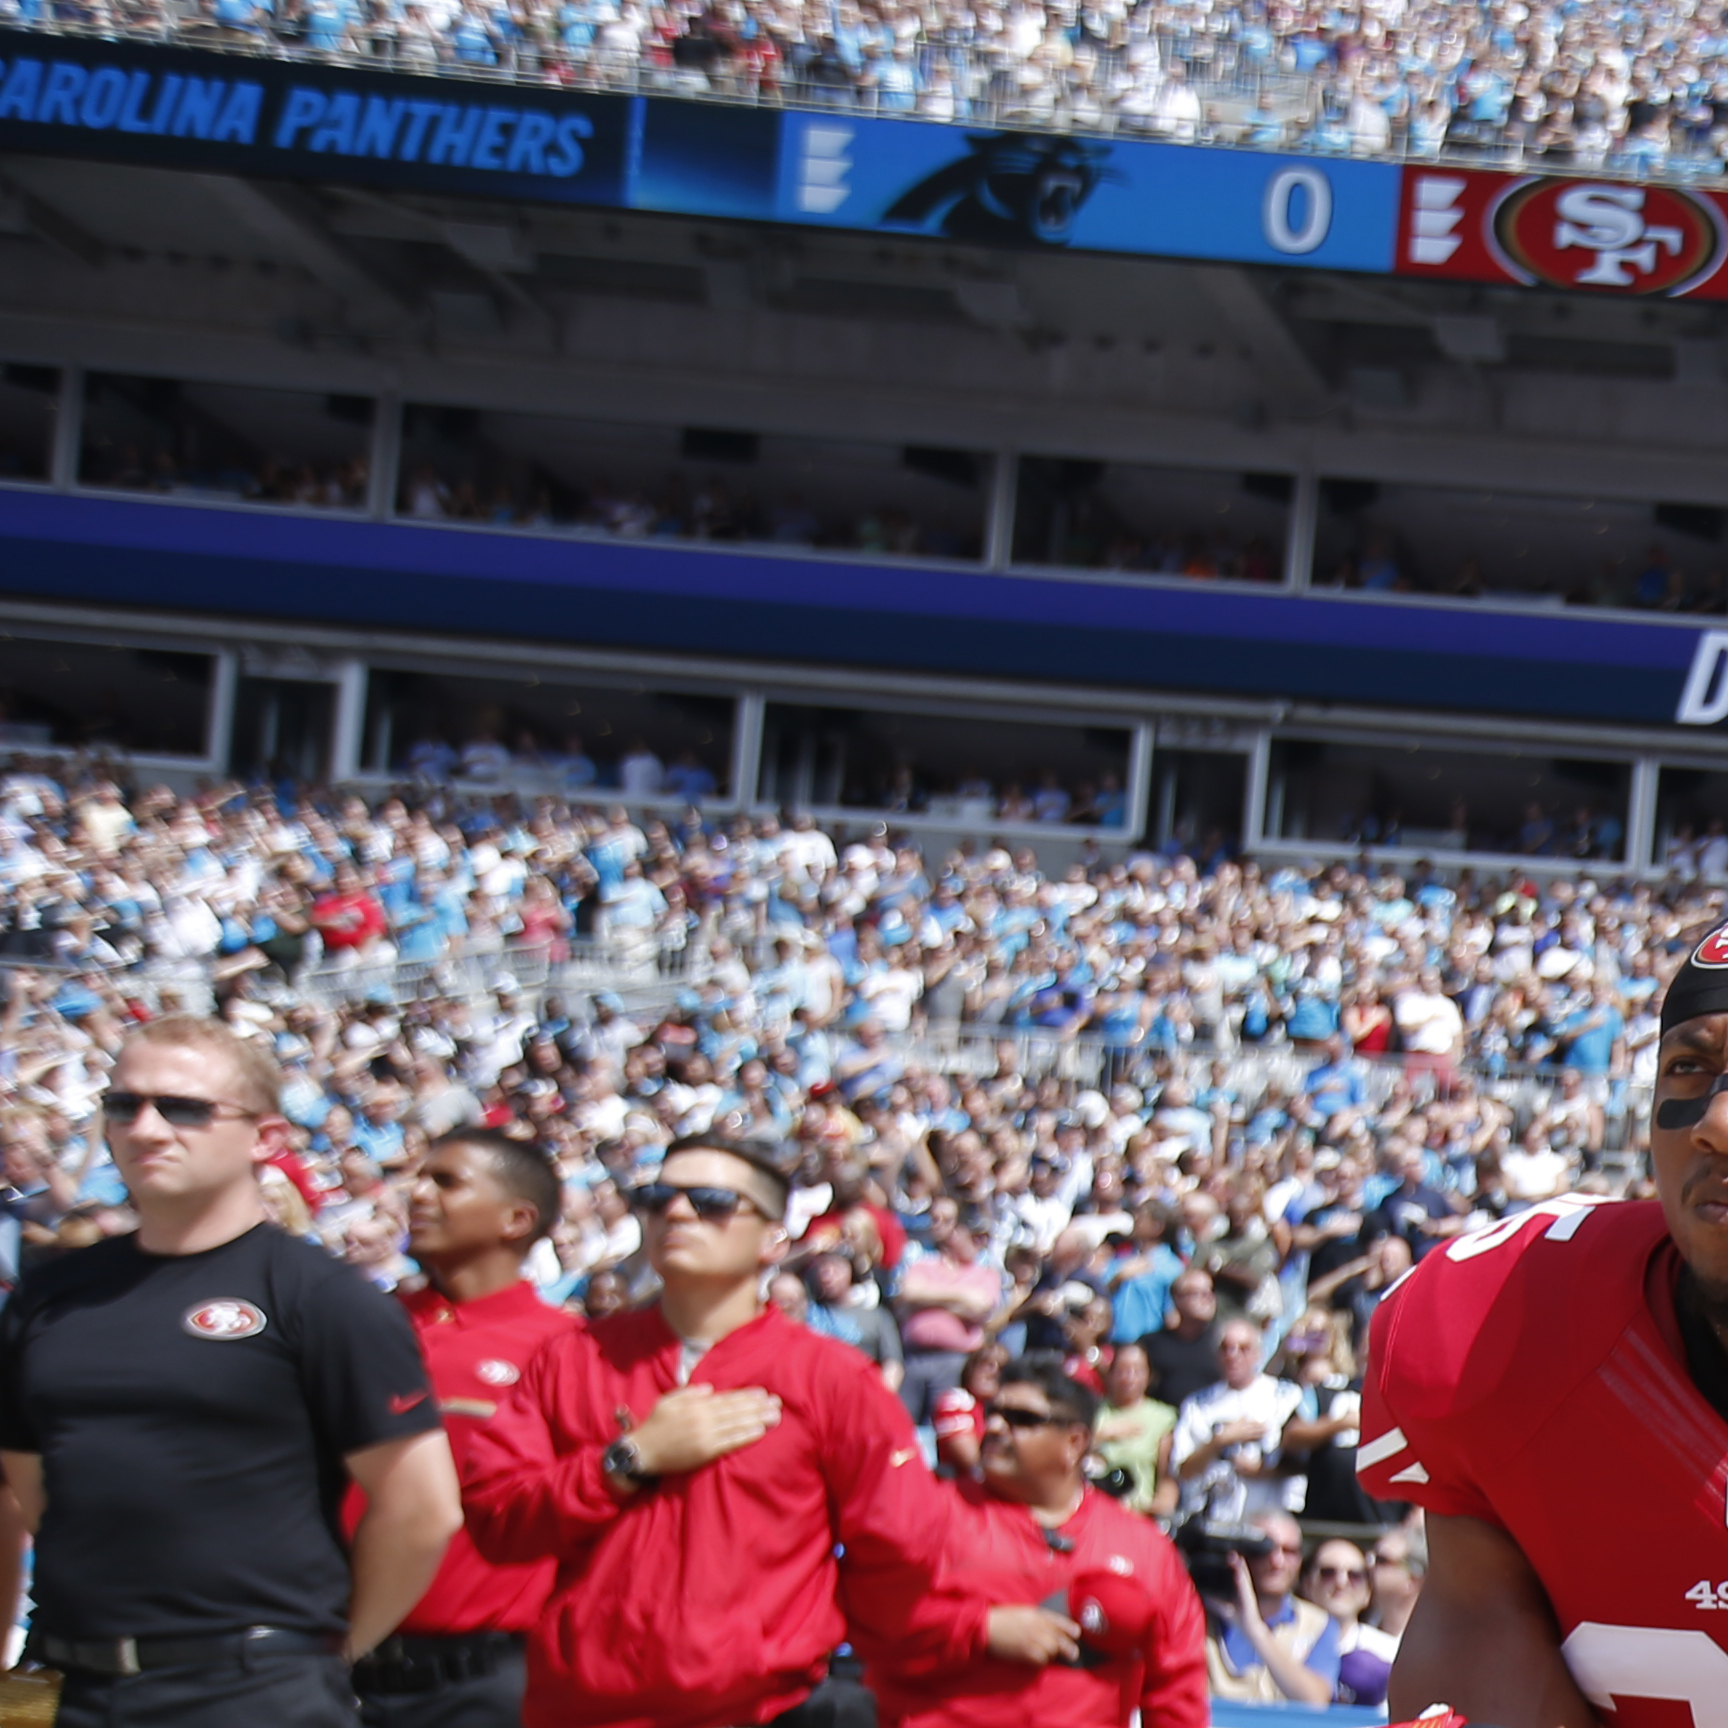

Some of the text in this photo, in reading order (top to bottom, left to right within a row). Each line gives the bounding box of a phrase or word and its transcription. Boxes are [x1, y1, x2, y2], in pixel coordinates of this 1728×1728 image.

[0, 56, 595, 178] AROLINA PANTHERS
[1264, 164, 1334, 255] 0
